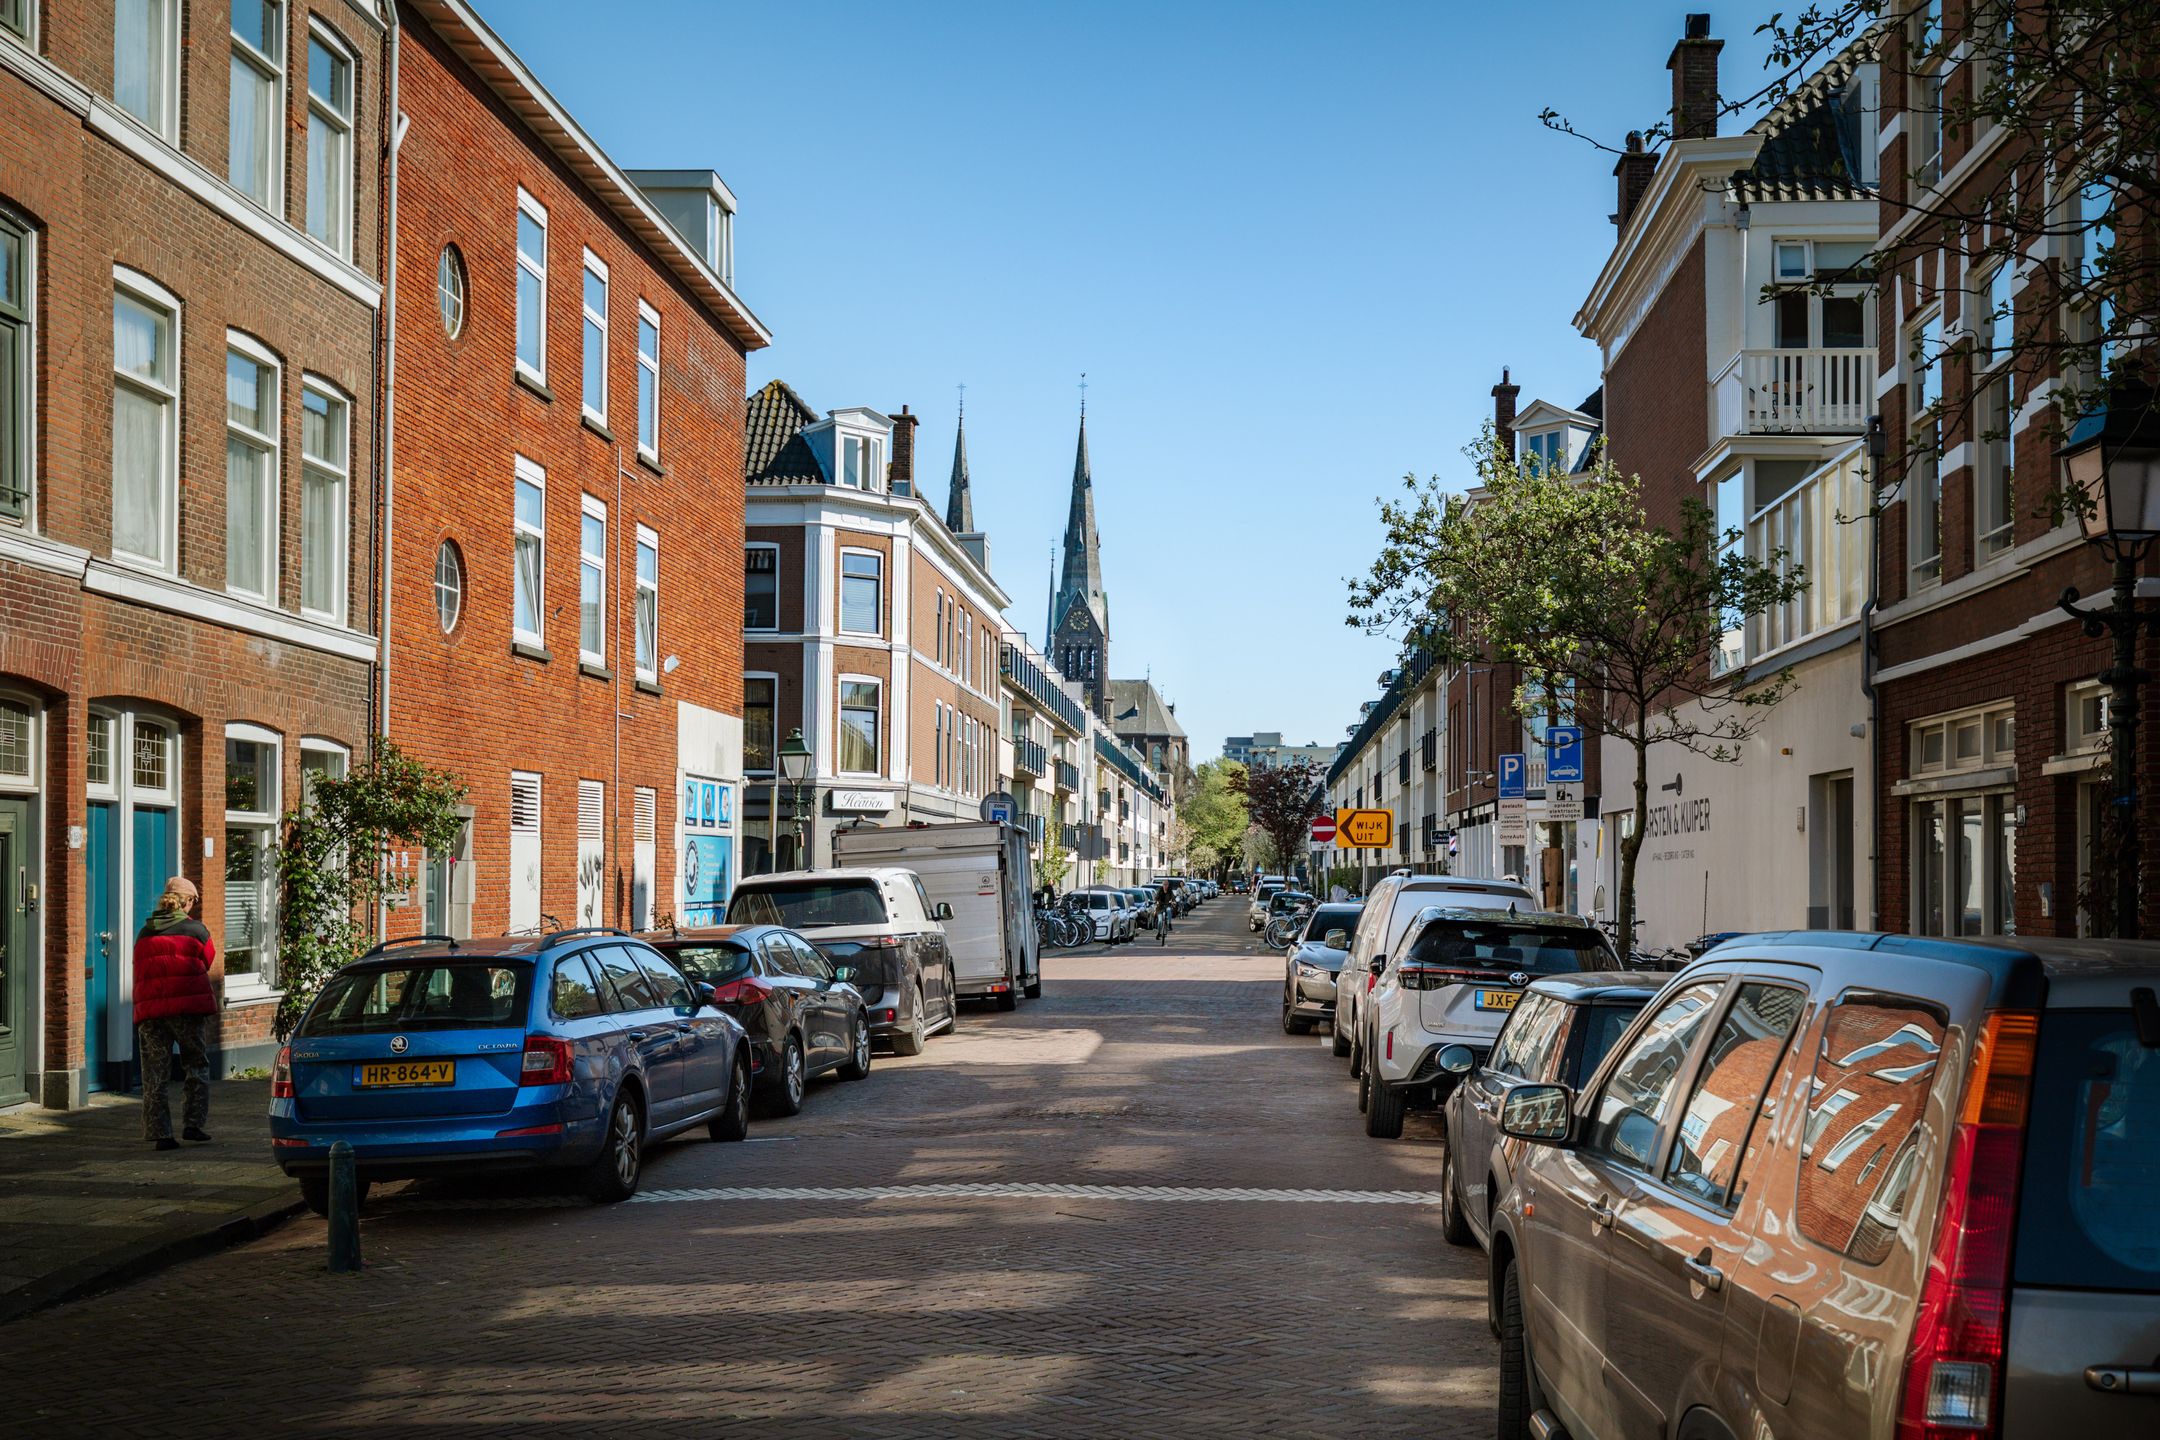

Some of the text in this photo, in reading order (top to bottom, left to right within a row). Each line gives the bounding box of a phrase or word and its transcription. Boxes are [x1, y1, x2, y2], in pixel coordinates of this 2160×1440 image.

[1554, 731, 1574, 759] P
[1504, 757, 1519, 781] P
[1356, 821, 1383, 830] WIJK
[1645, 797, 1711, 838] ARSTEN & KUIPER
[1356, 833, 1374, 841] UIT
[1487, 993, 1518, 1006] JXF-
[478, 1042, 519, 1050] OCTAVIA
[367, 1063, 449, 1083] HR-864-V
